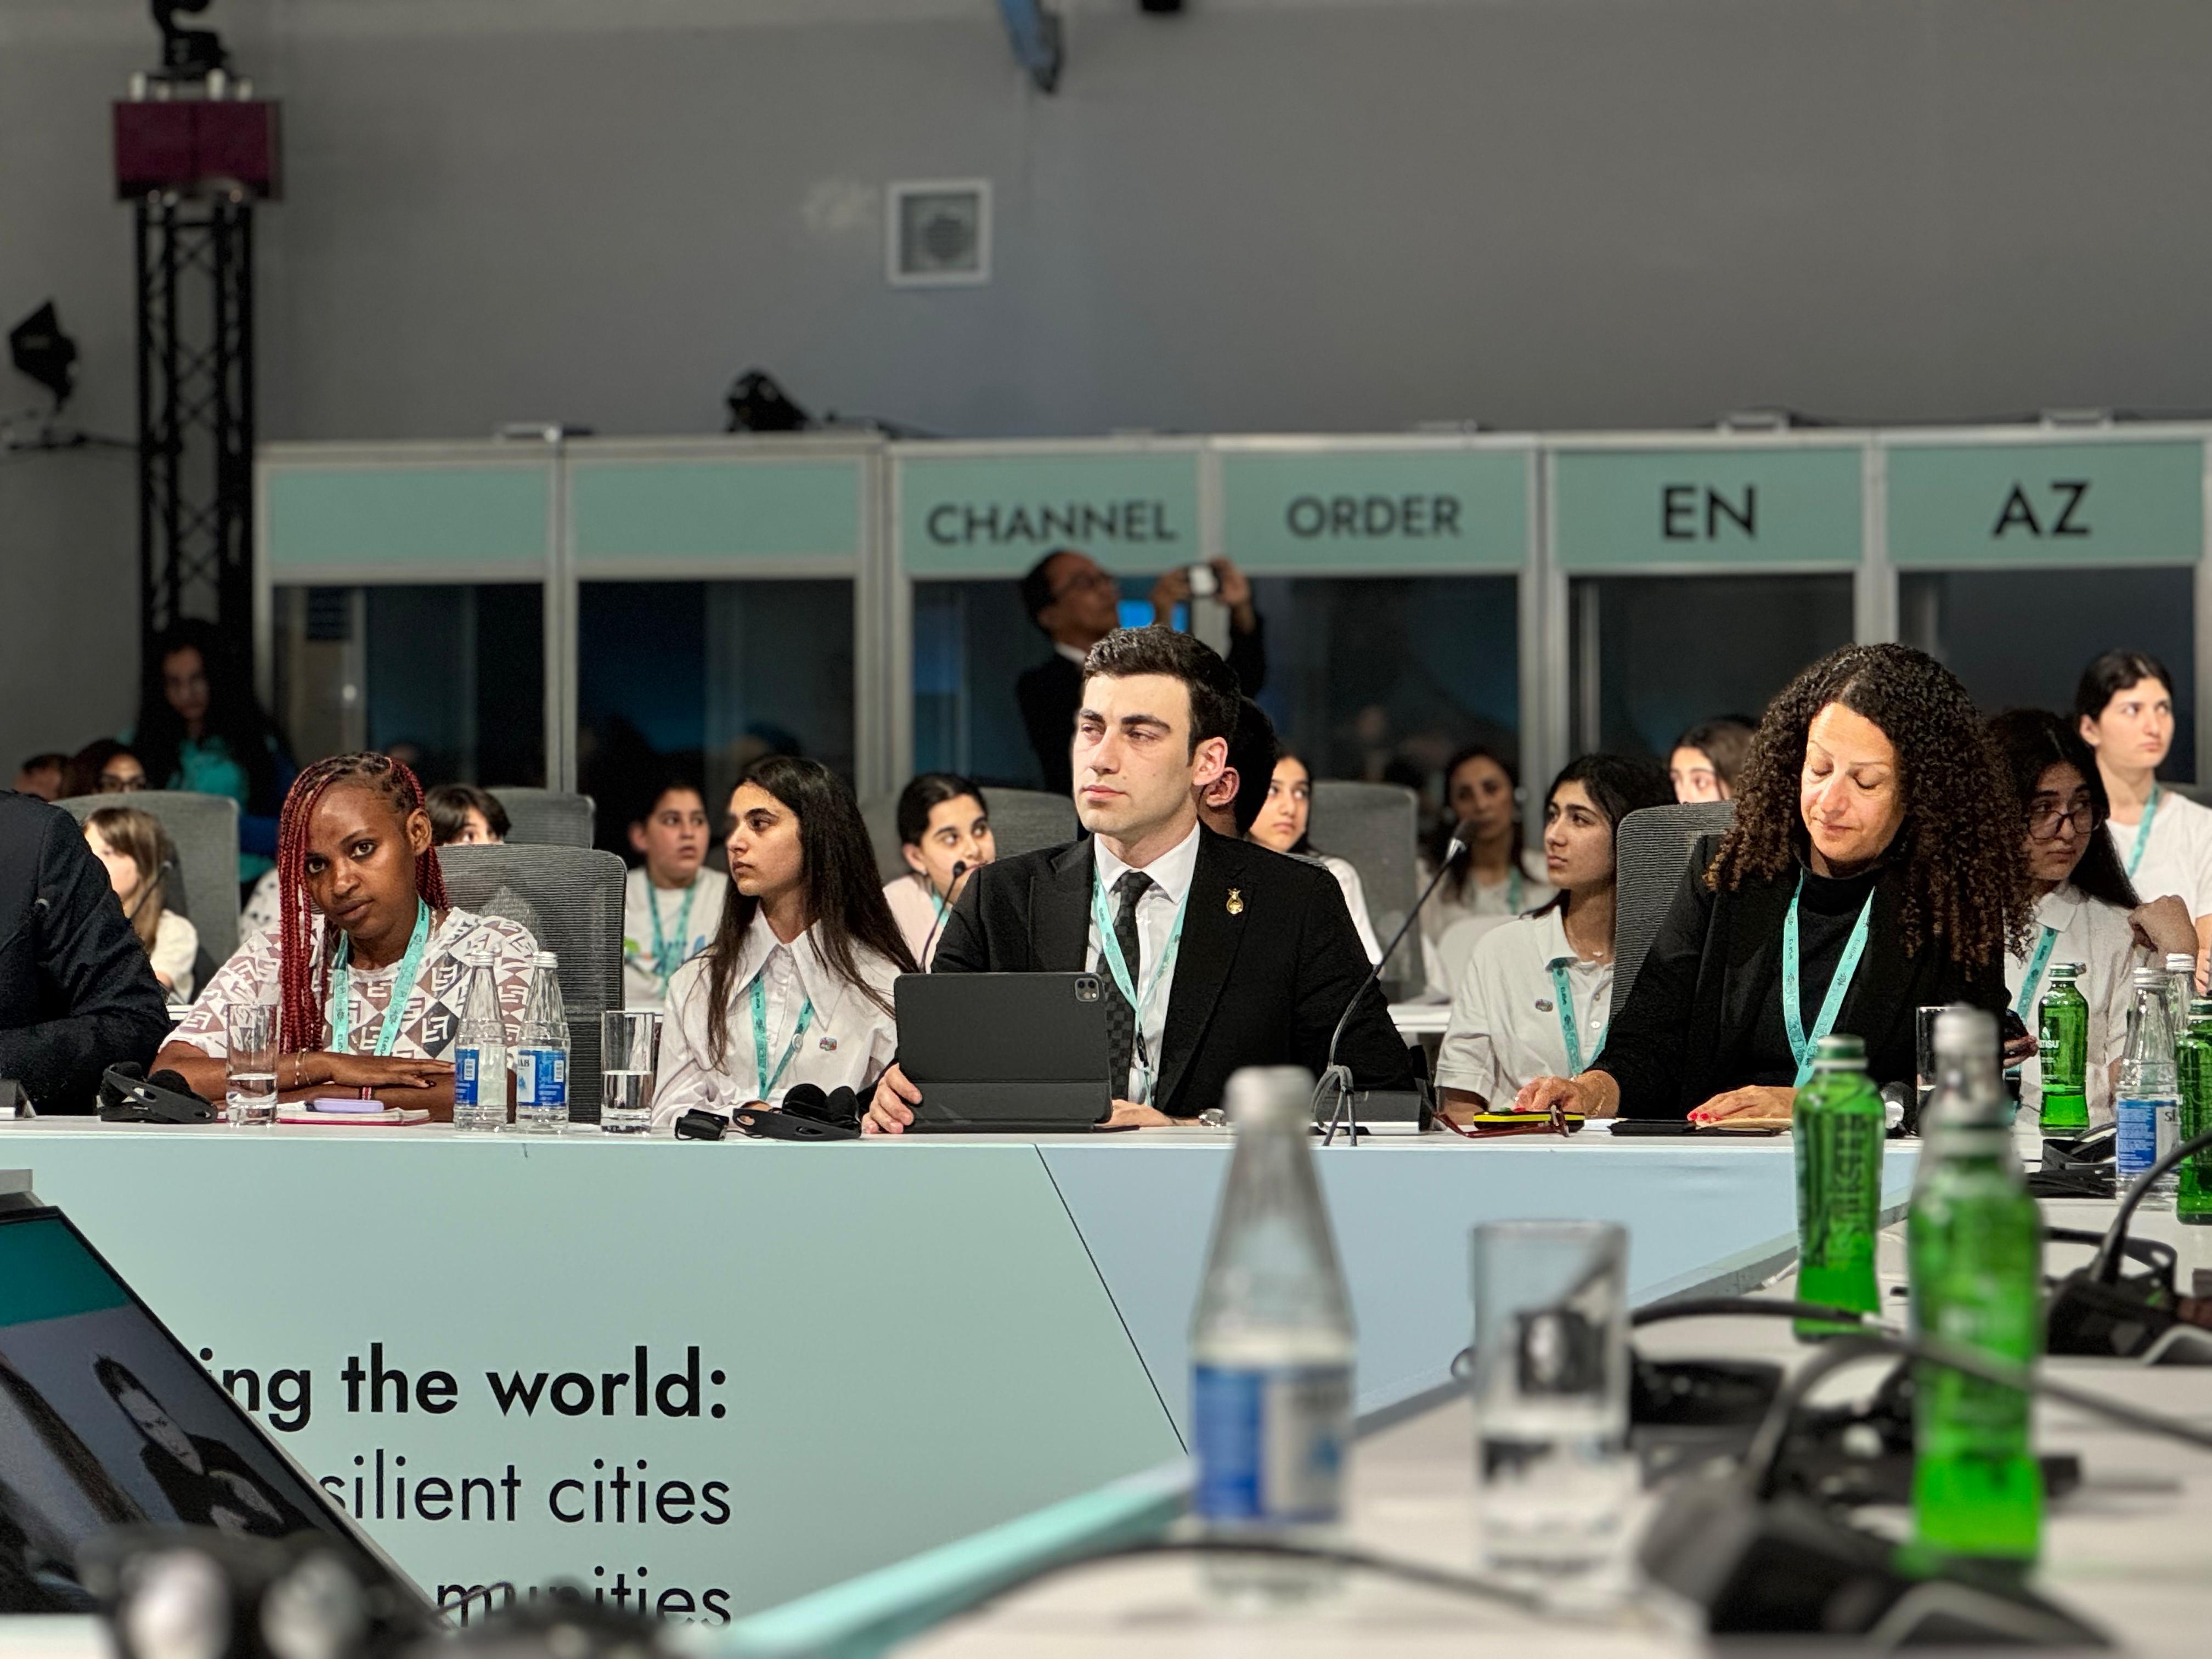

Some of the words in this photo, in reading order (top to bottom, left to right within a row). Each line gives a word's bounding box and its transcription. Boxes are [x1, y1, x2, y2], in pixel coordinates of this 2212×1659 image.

[926, 500, 1176, 545] CHANNEL
[1285, 495, 1461, 539] ORDER
[1661, 484, 1757, 540] EN
[1991, 481, 2091, 538] AZ
[200, 1347, 311, 1432] ng
[340, 1342, 459, 1415] the
[485, 1345, 726, 1419] world:
[549, 1458, 731, 1526] cities
